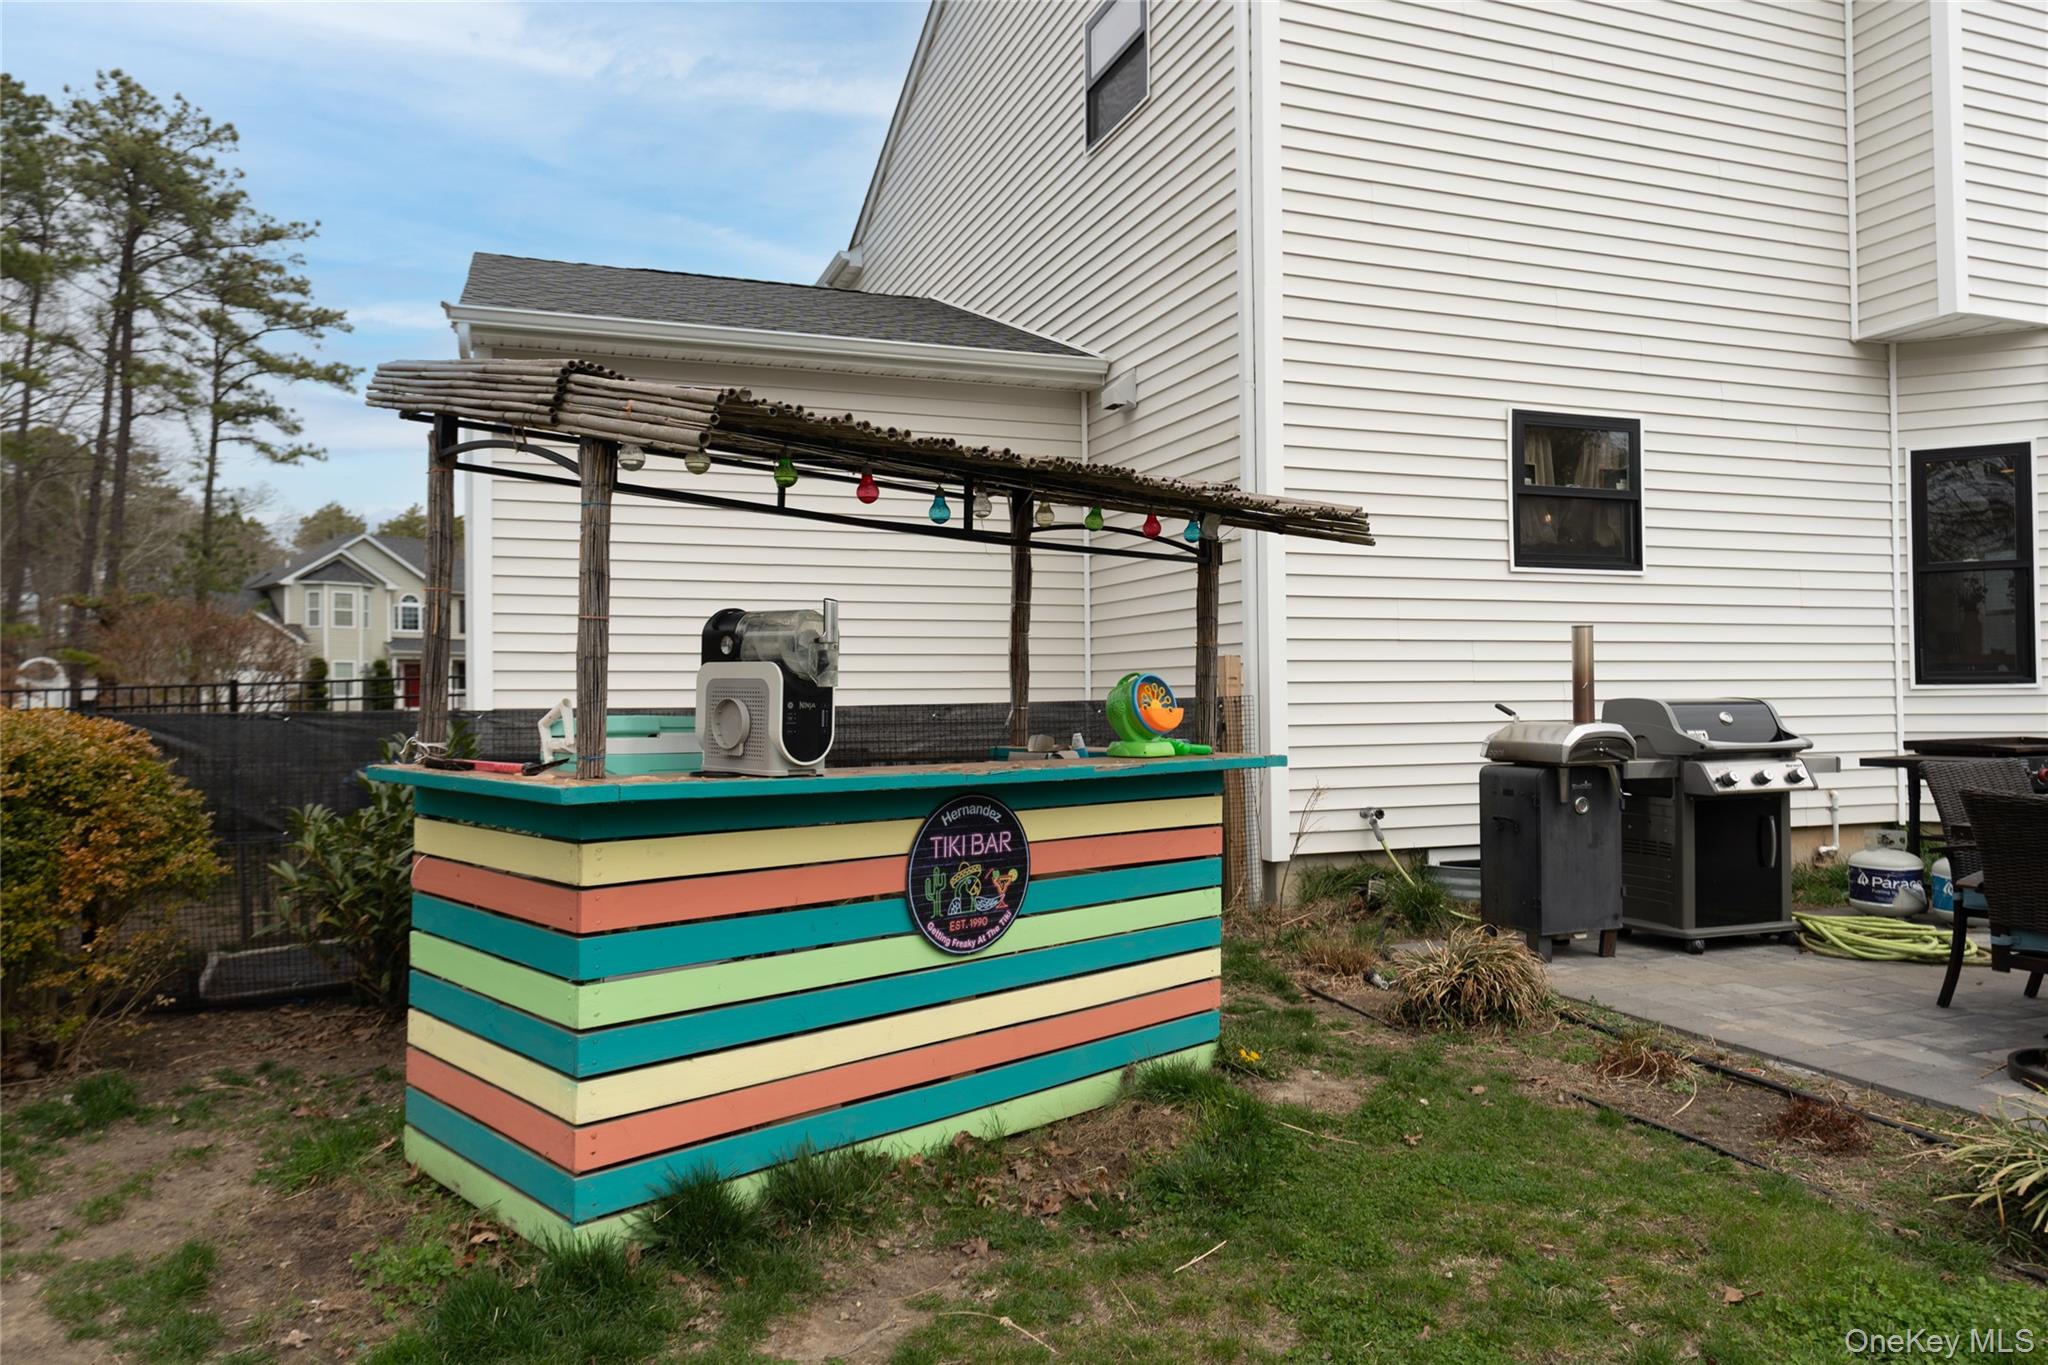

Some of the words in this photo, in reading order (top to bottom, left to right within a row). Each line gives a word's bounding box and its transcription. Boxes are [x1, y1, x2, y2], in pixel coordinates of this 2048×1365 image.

[942, 804, 1002, 826] Hernandez
[930, 832, 966, 859] TIKI
[971, 831, 1012, 855] BAR
[927, 921, 951, 947] Getting
[951, 938, 976, 949] Freaky
[977, 935, 986, 944] At
[986, 925, 1000, 938] The
[949, 919, 968, 932] EST.
[970, 916, 988, 929] 1990
